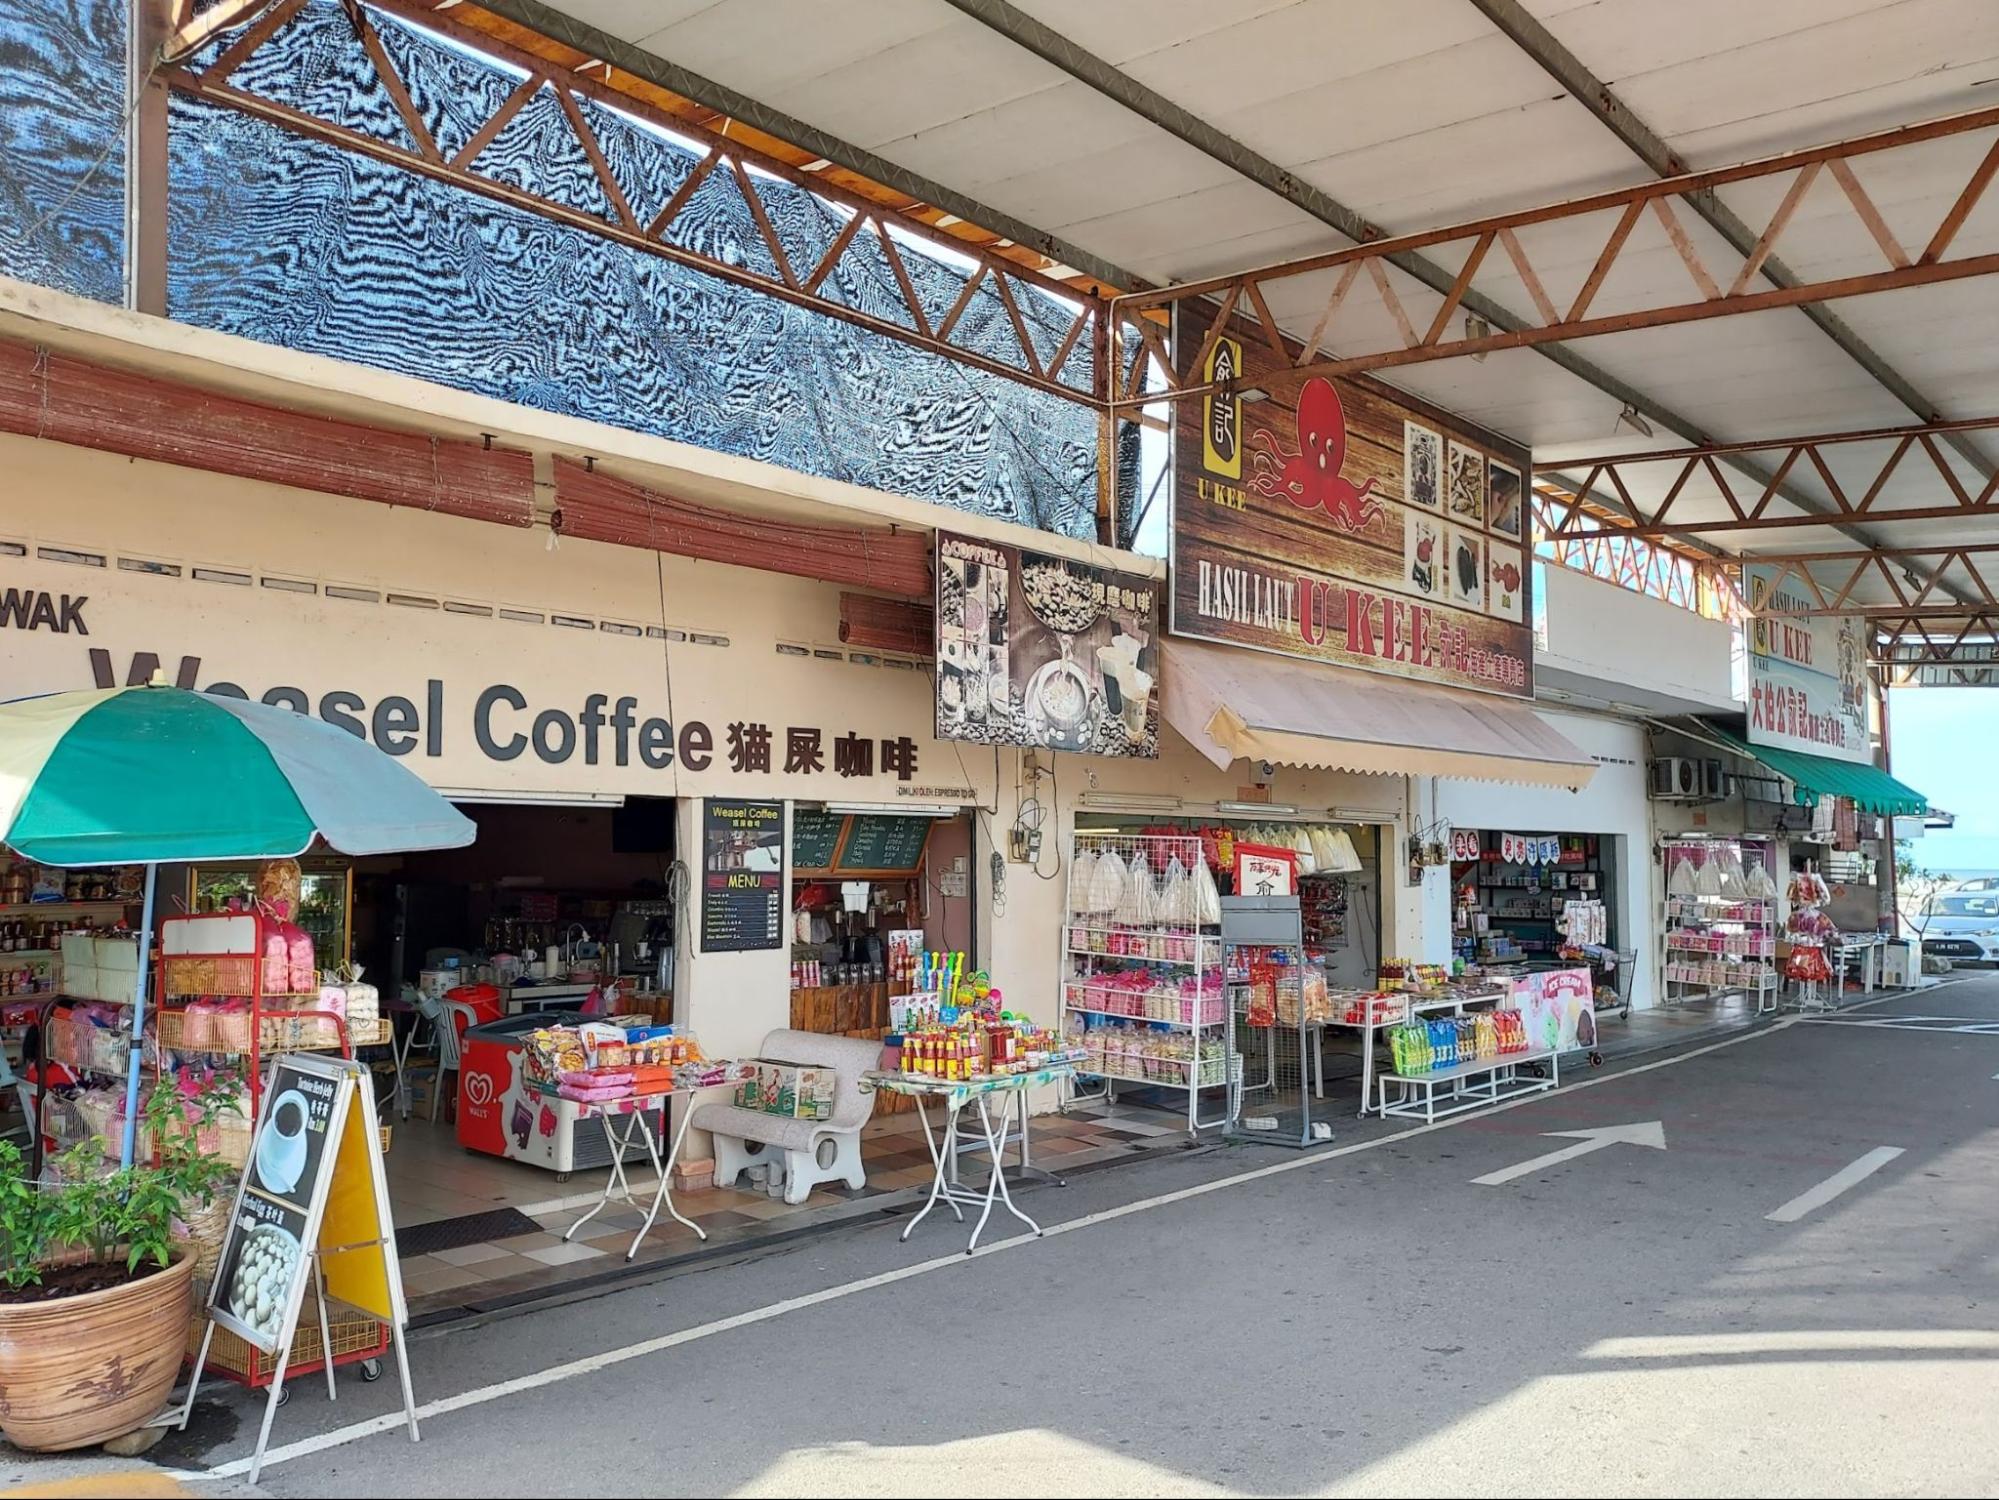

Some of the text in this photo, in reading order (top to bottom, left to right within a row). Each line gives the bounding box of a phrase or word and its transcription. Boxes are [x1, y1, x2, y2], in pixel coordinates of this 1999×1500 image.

[1198, 477, 1247, 512] U KEE
[951, 540, 998, 566] COFFEE
[0, 587, 89, 636] WAK
[1198, 559, 1434, 670] HASIL LAUT U KEE
[1768, 619, 1813, 666] U KEE
[89, 647, 713, 773] Wsel Coffee
[726, 720, 919, 781] 猫屎咖啡
[712, 806, 778, 820] Weasel Coffee
[727, 873, 761, 889] MENU
[1548, 976, 1581, 992] ICE CREAM
